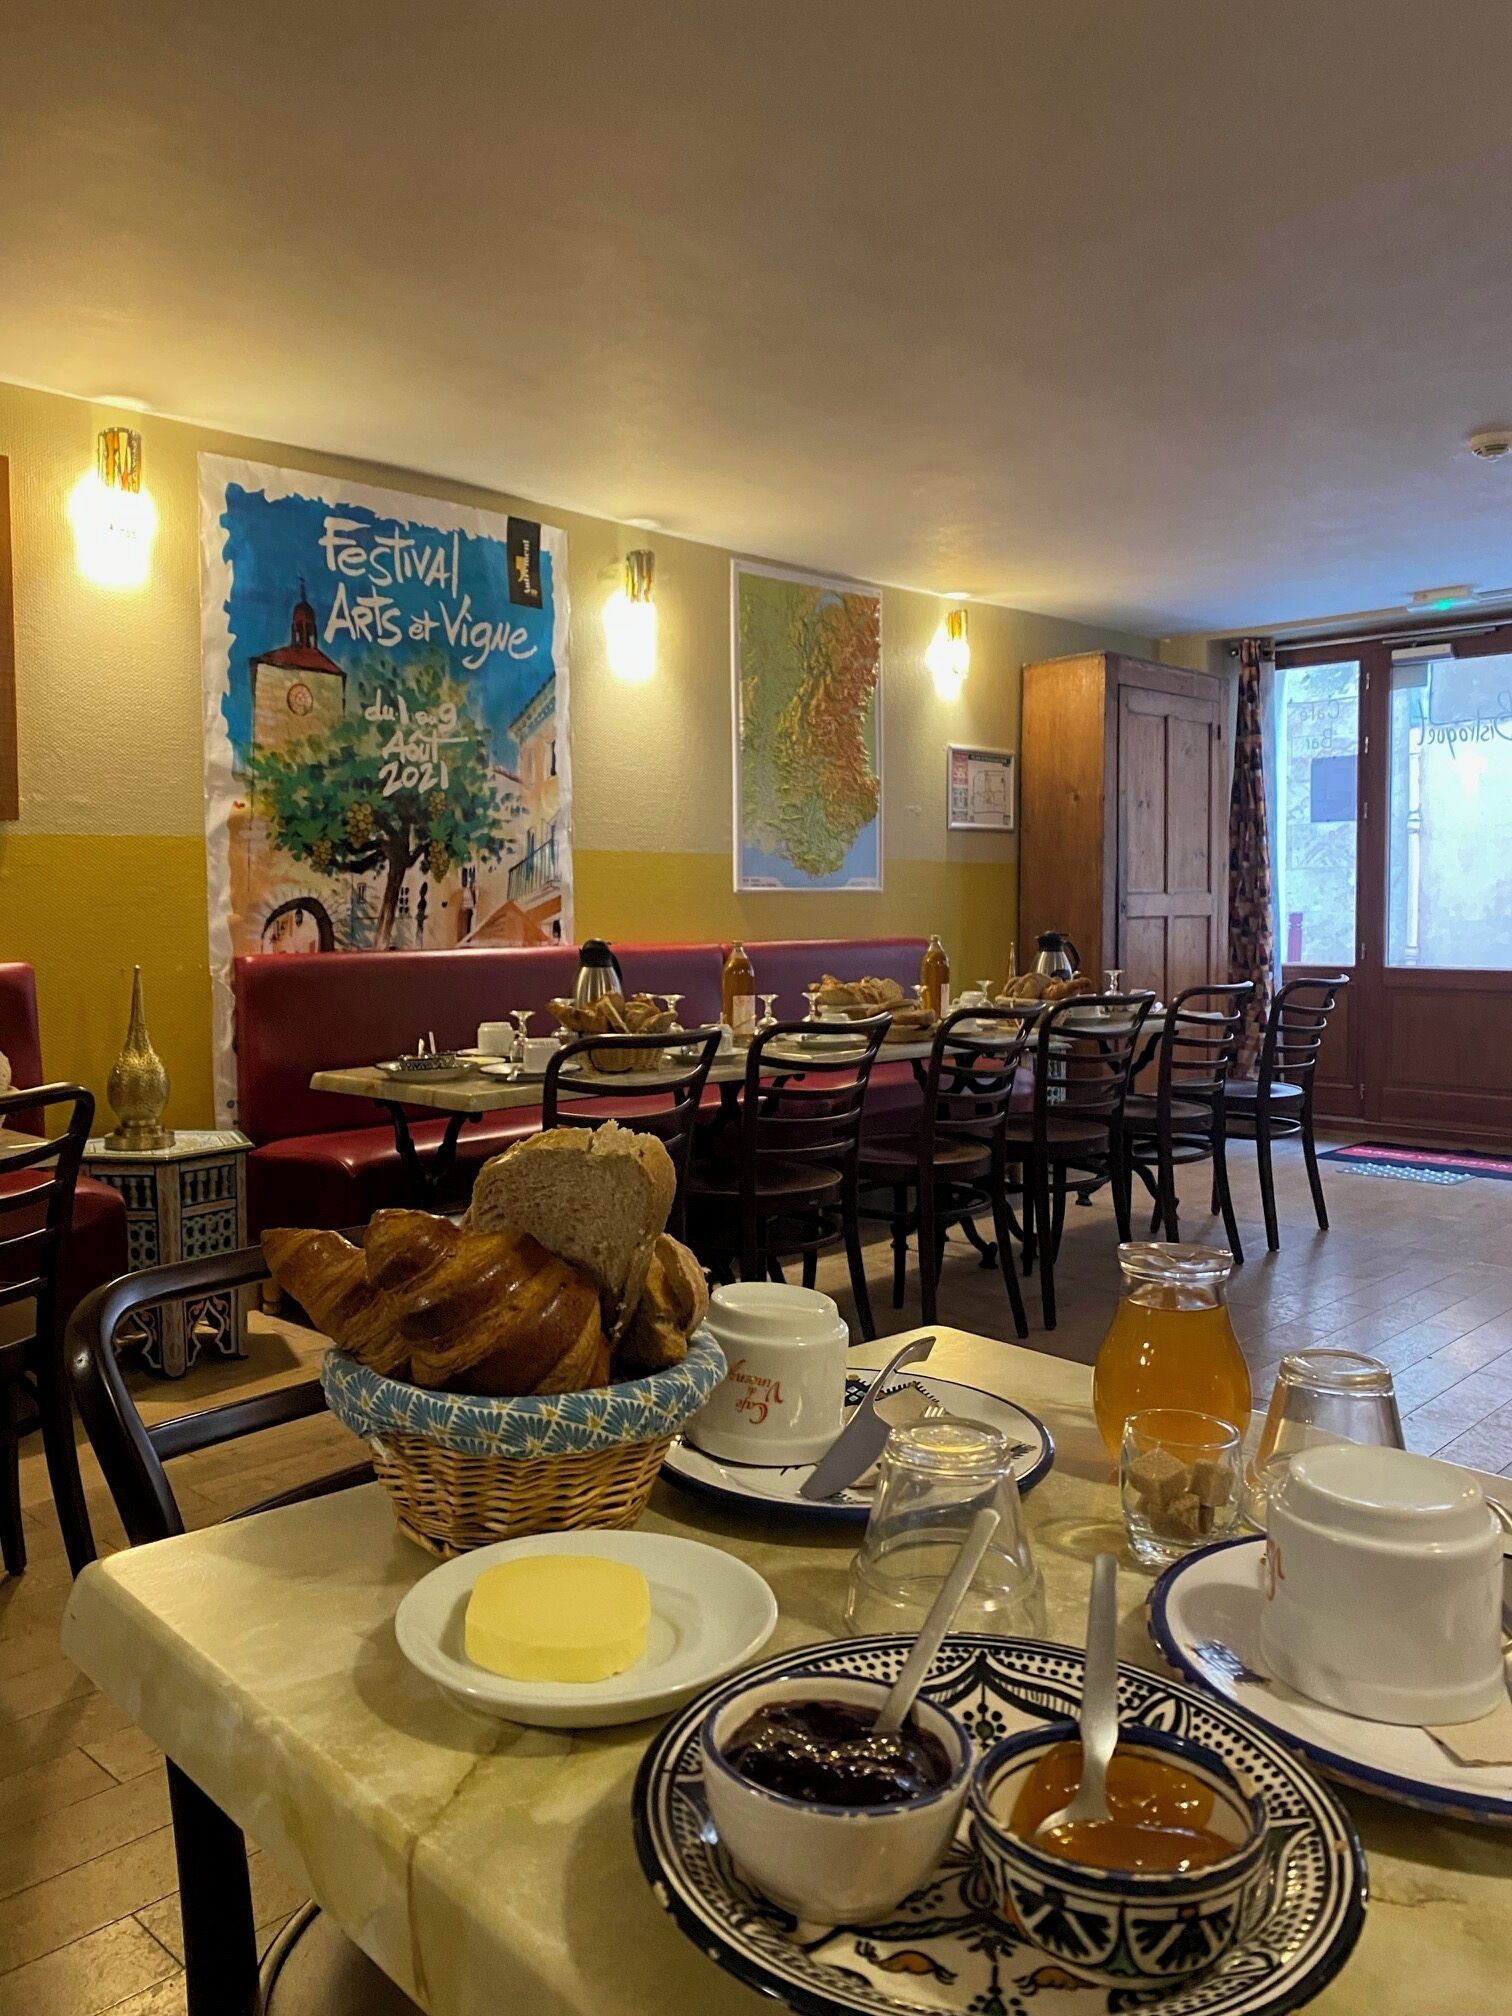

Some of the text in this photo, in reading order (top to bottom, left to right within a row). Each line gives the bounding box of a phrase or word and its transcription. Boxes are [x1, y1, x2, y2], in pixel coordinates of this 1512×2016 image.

[408, 609, 440, 642] et
[364, 688, 396, 721] du
[437, 702, 458, 736] 9
[378, 760, 449, 797] 2021
